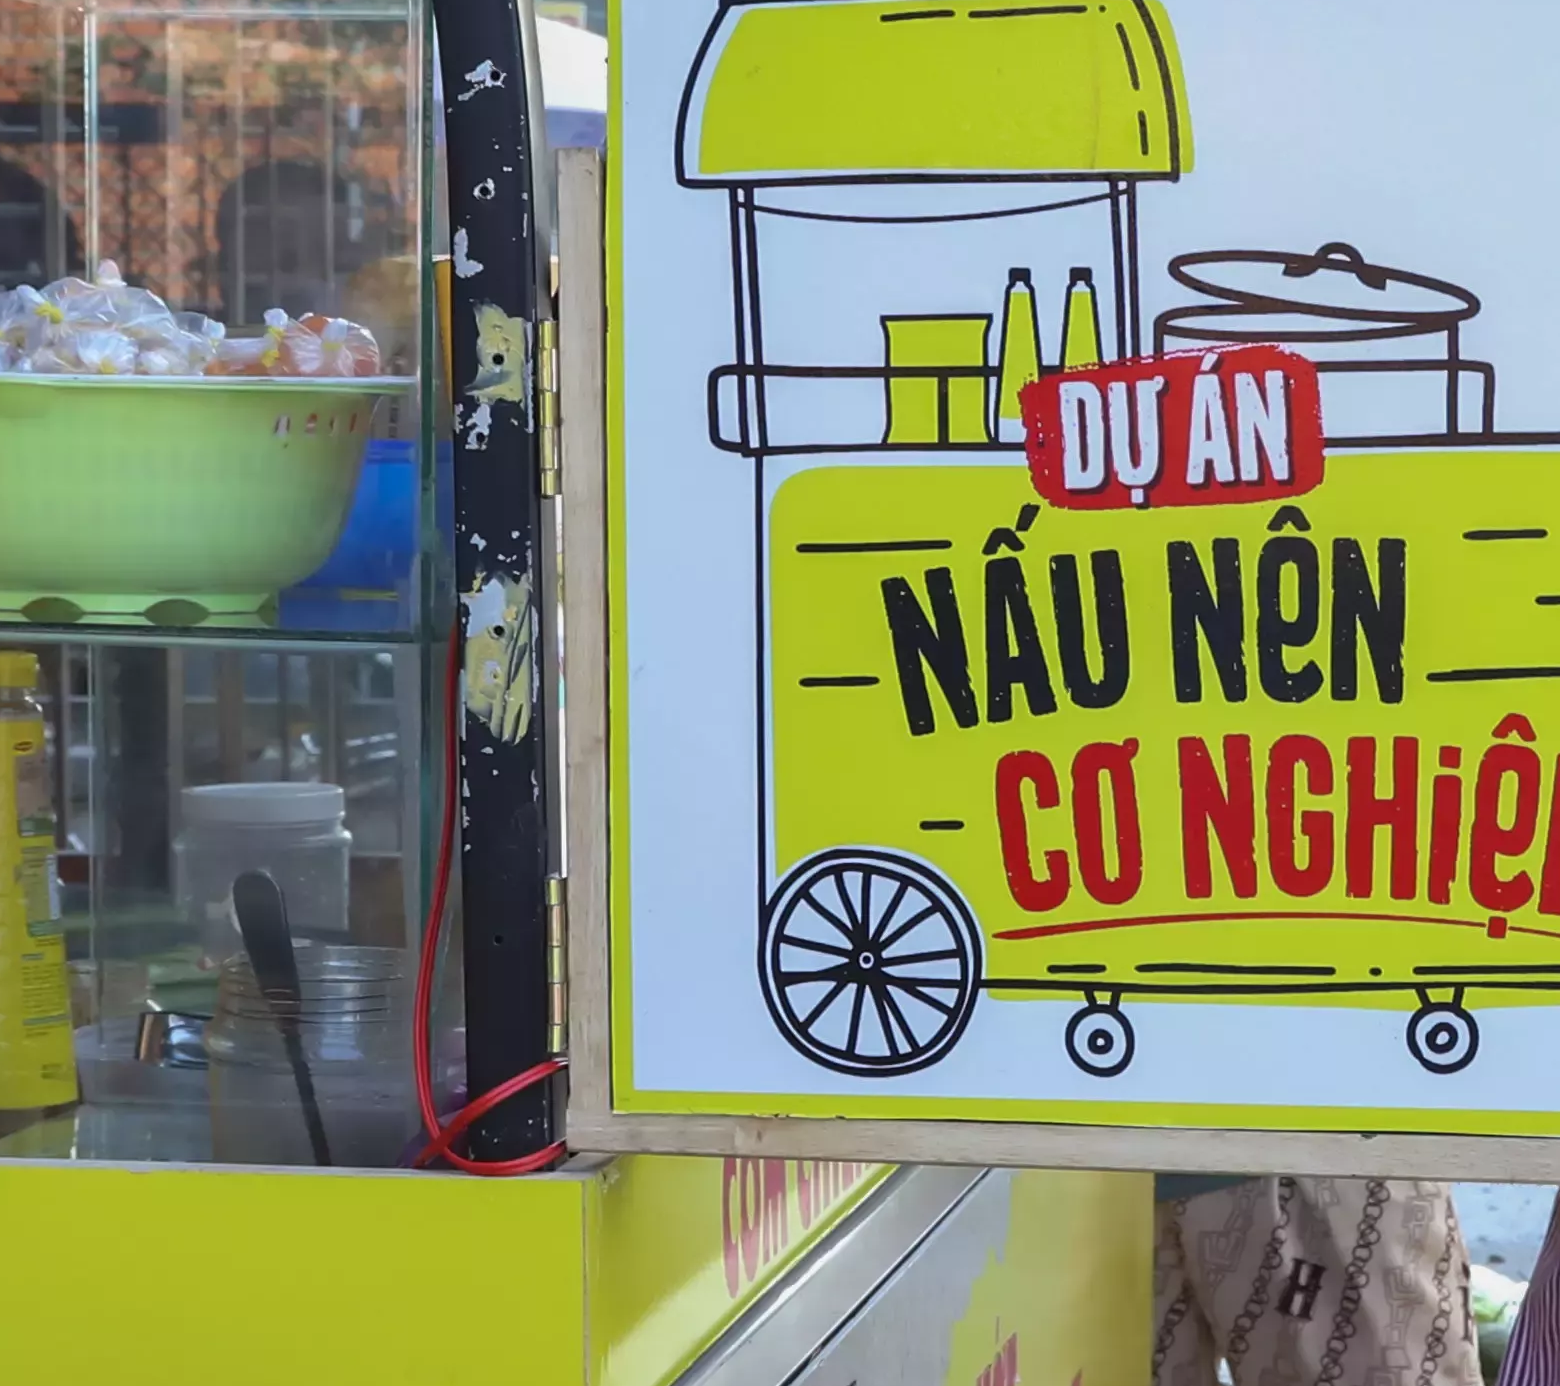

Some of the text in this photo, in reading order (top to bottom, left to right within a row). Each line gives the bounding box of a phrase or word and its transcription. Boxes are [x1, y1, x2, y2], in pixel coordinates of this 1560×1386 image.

[1055, 350, 1293, 505] DỰ ÁN
[880, 504, 1132, 735] NẤU
[993, 734, 1146, 911] CƠ
